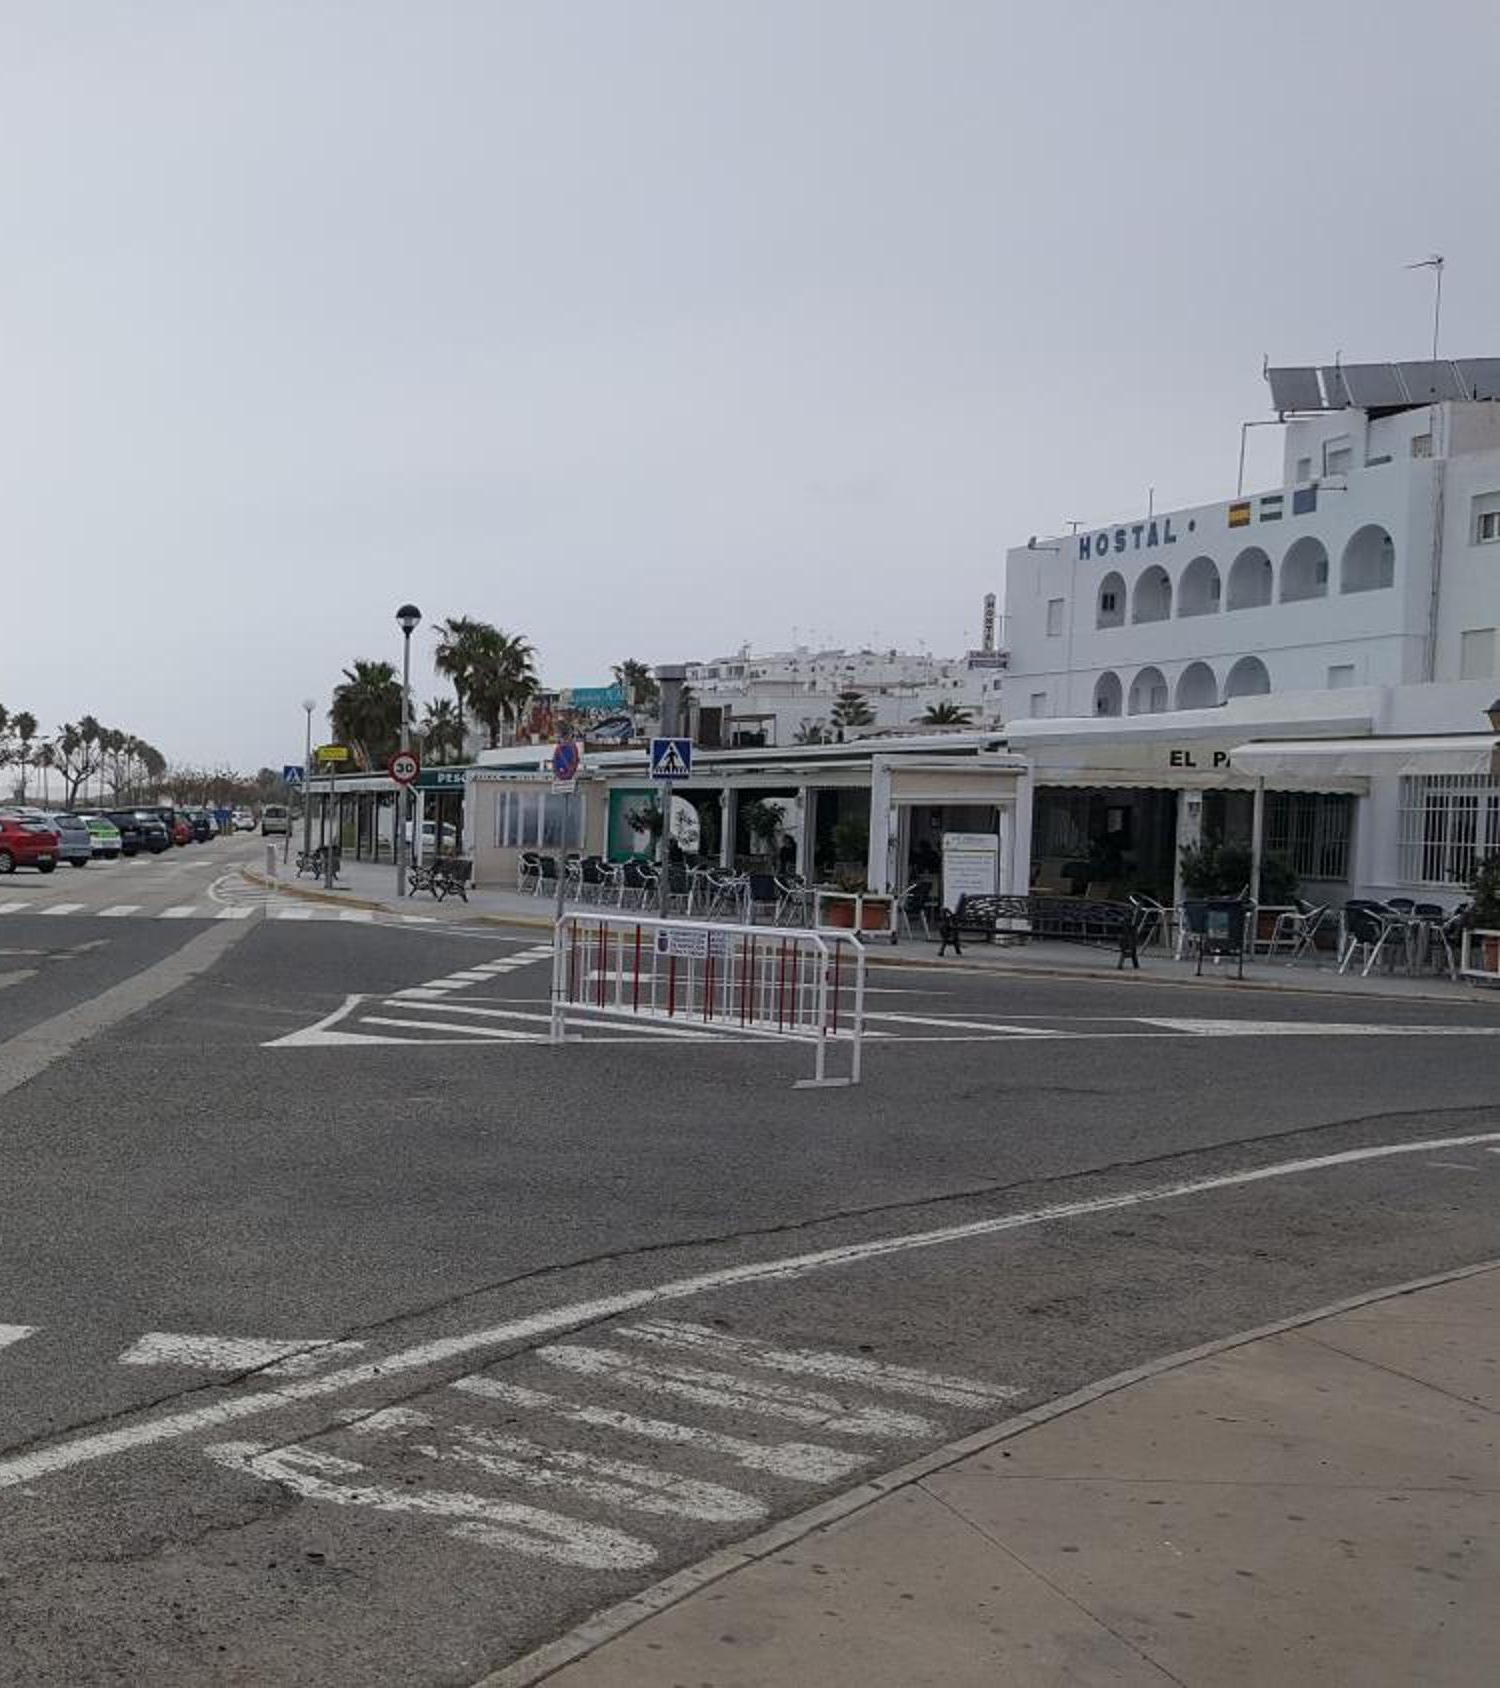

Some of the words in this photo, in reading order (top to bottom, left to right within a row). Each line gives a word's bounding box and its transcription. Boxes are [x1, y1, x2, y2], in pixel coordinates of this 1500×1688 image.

[1079, 518, 1177, 561] HOSTAL
[395, 763, 414, 773] 30
[1169, 750, 1197, 768] EL
